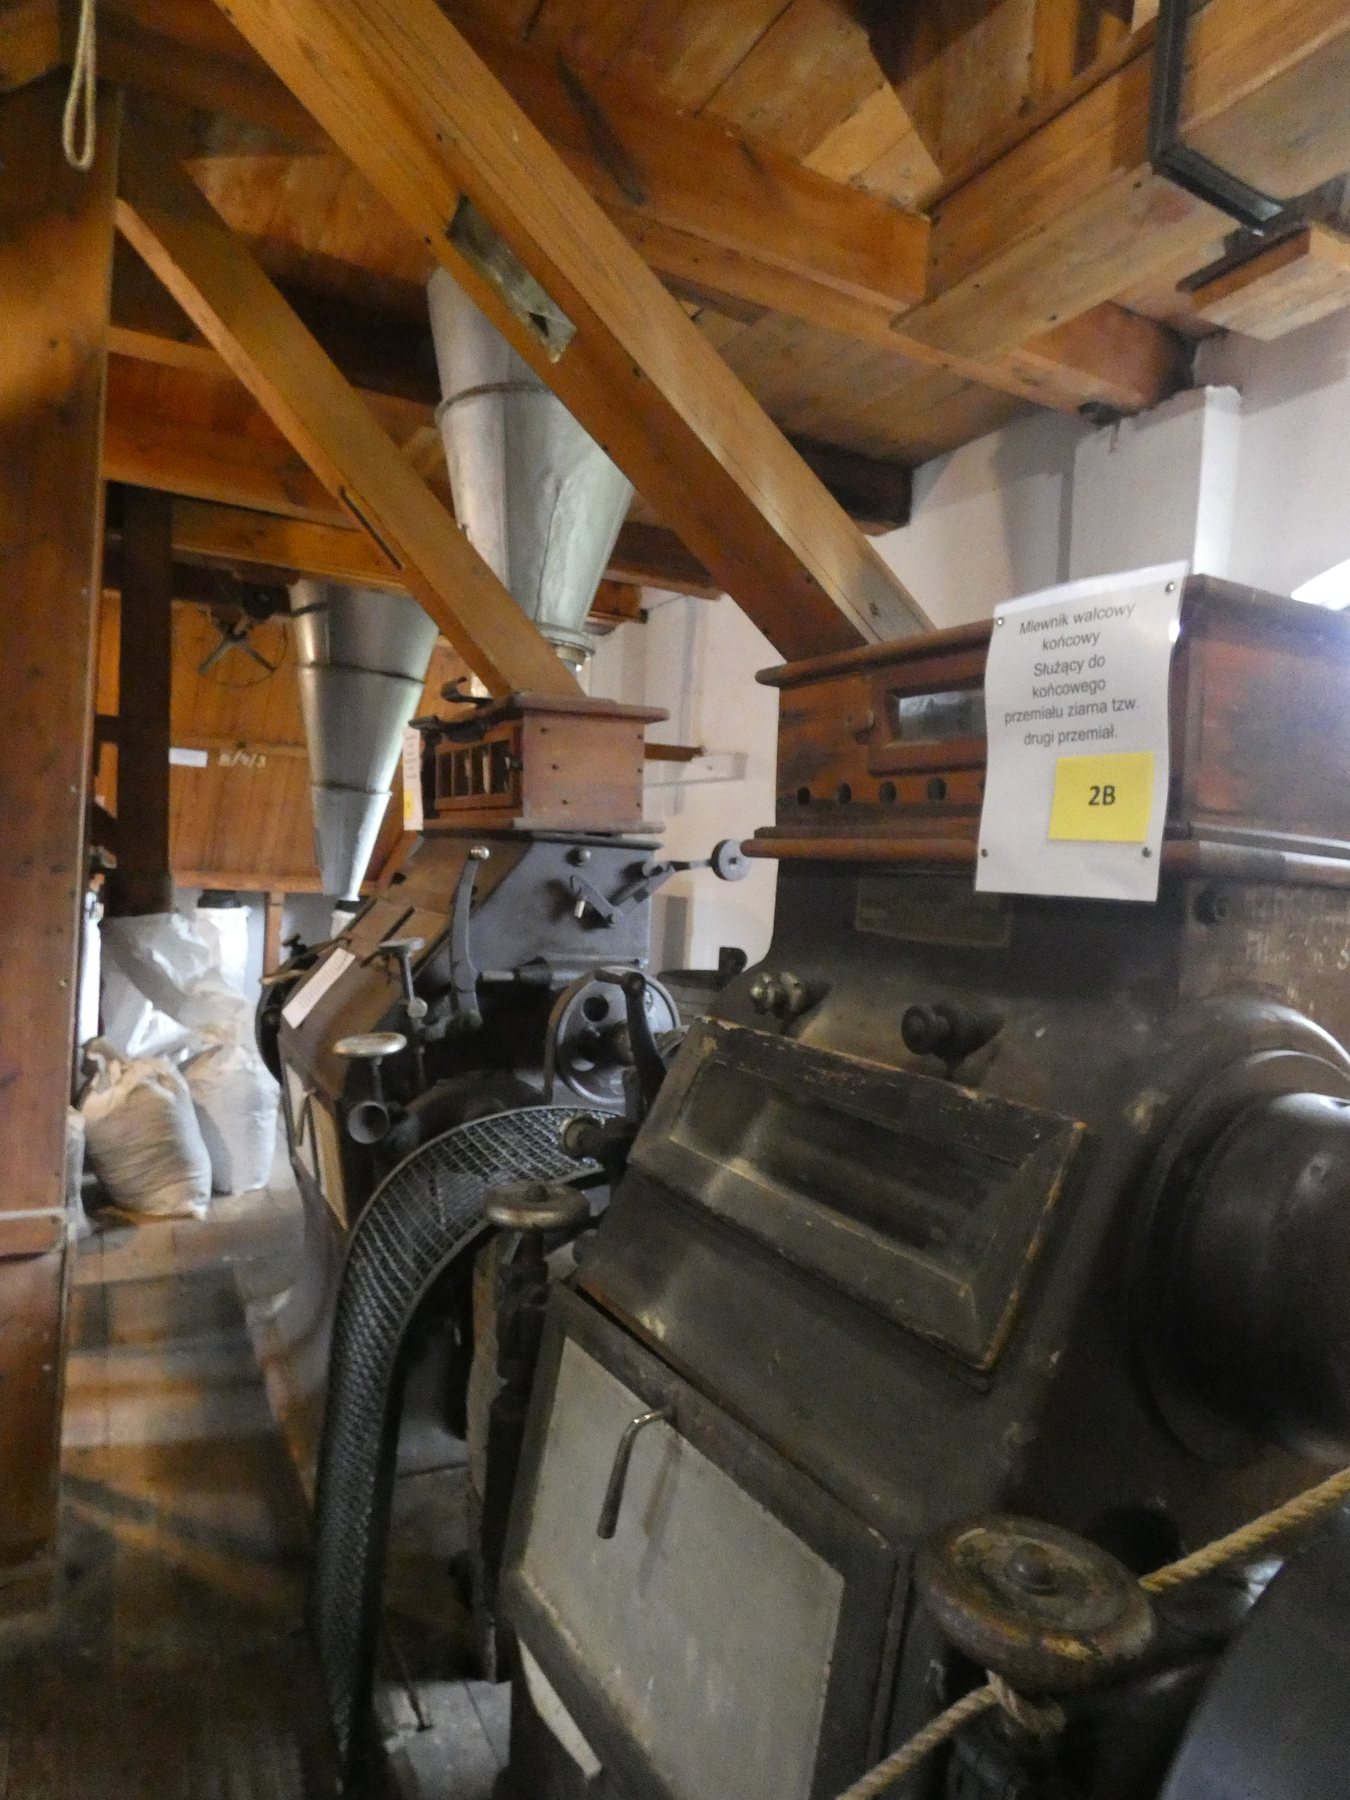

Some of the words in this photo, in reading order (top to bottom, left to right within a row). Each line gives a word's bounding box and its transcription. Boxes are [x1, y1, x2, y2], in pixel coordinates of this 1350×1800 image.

[1019, 613, 1069, 635] Mlewnik
[1073, 604, 1136, 623] walcowy
[1042, 631, 1101, 651] końcowy
[1033, 658, 1085, 677] Służący
[1088, 654, 1106, 668] do
[1032, 678, 1107, 698] końcowego
[1004, 706, 1063, 725] przemiału
[1067, 701, 1108, 717] ziarna
[1112, 697, 1140, 713] tzw.
[1023, 731, 1055, 747] drugi
[1058, 725, 1118, 747] przemiał.
[1087, 785, 1116, 806] 2B
